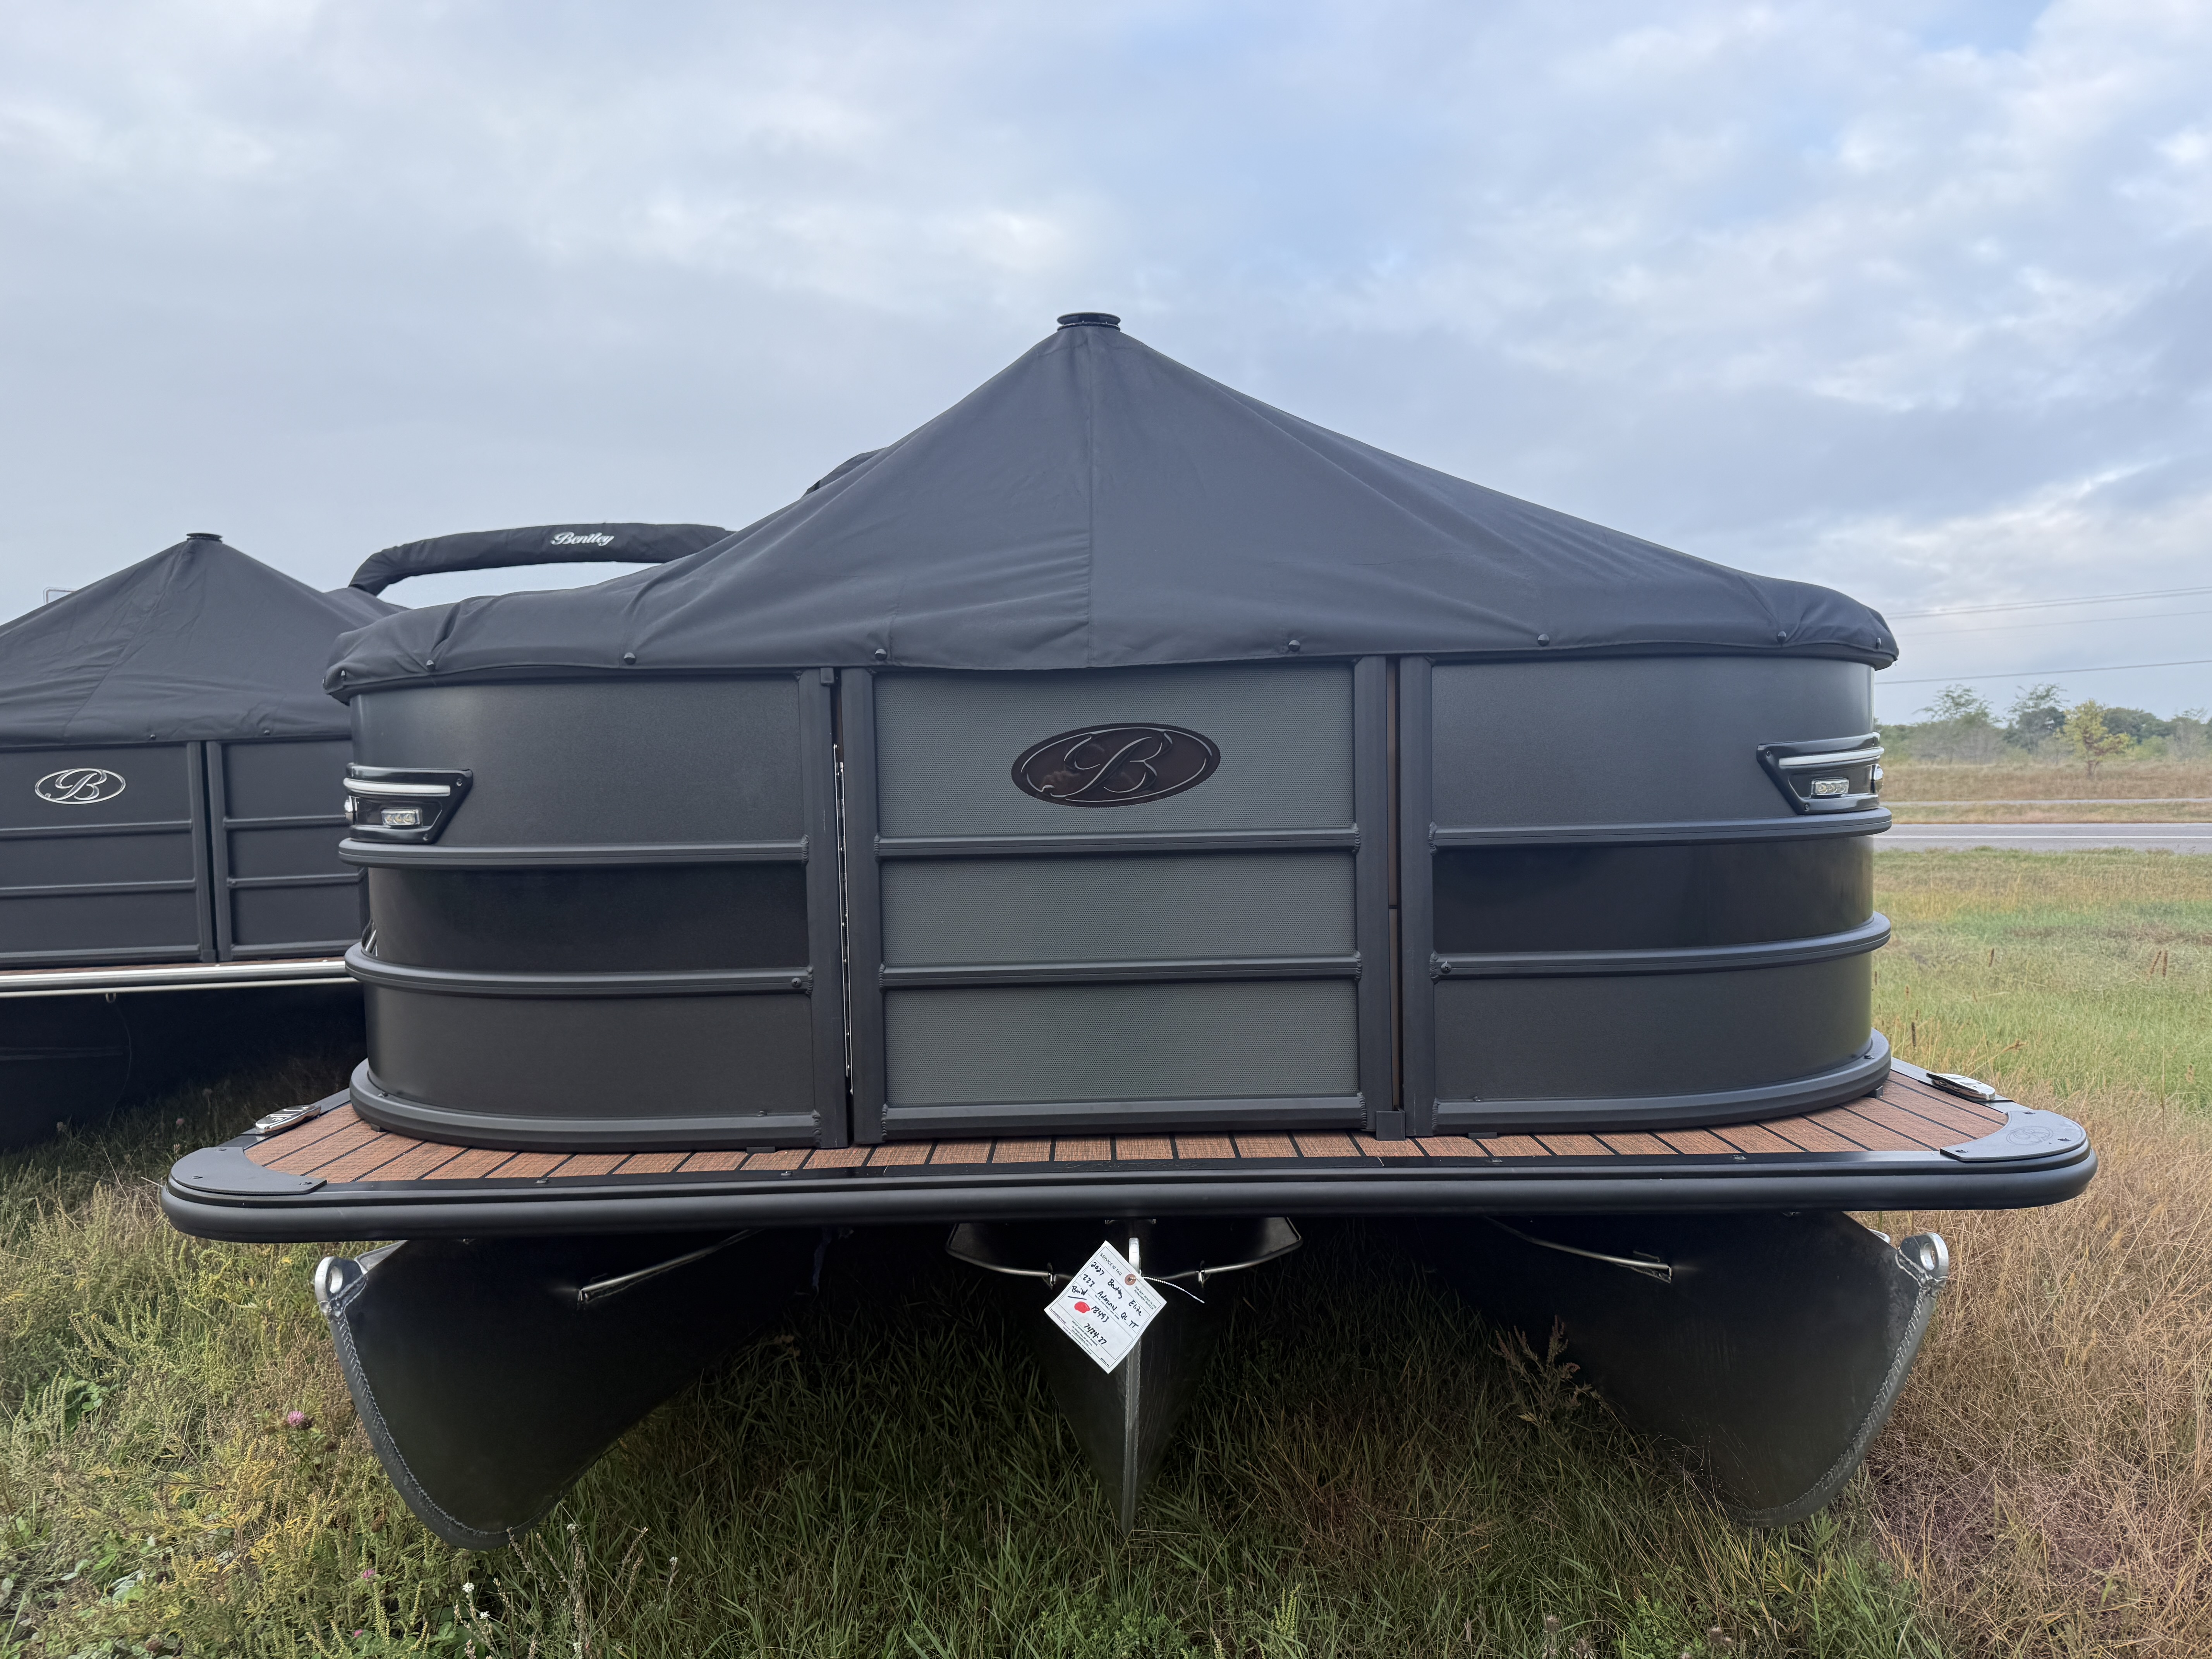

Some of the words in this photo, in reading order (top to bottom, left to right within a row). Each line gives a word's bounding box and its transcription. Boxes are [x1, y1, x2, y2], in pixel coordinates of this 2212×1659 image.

[550, 532, 615, 546] Bentley
[1100, 1253, 1113, 1266] SERVICE
[1091, 1262, 1104, 1276] 2027
